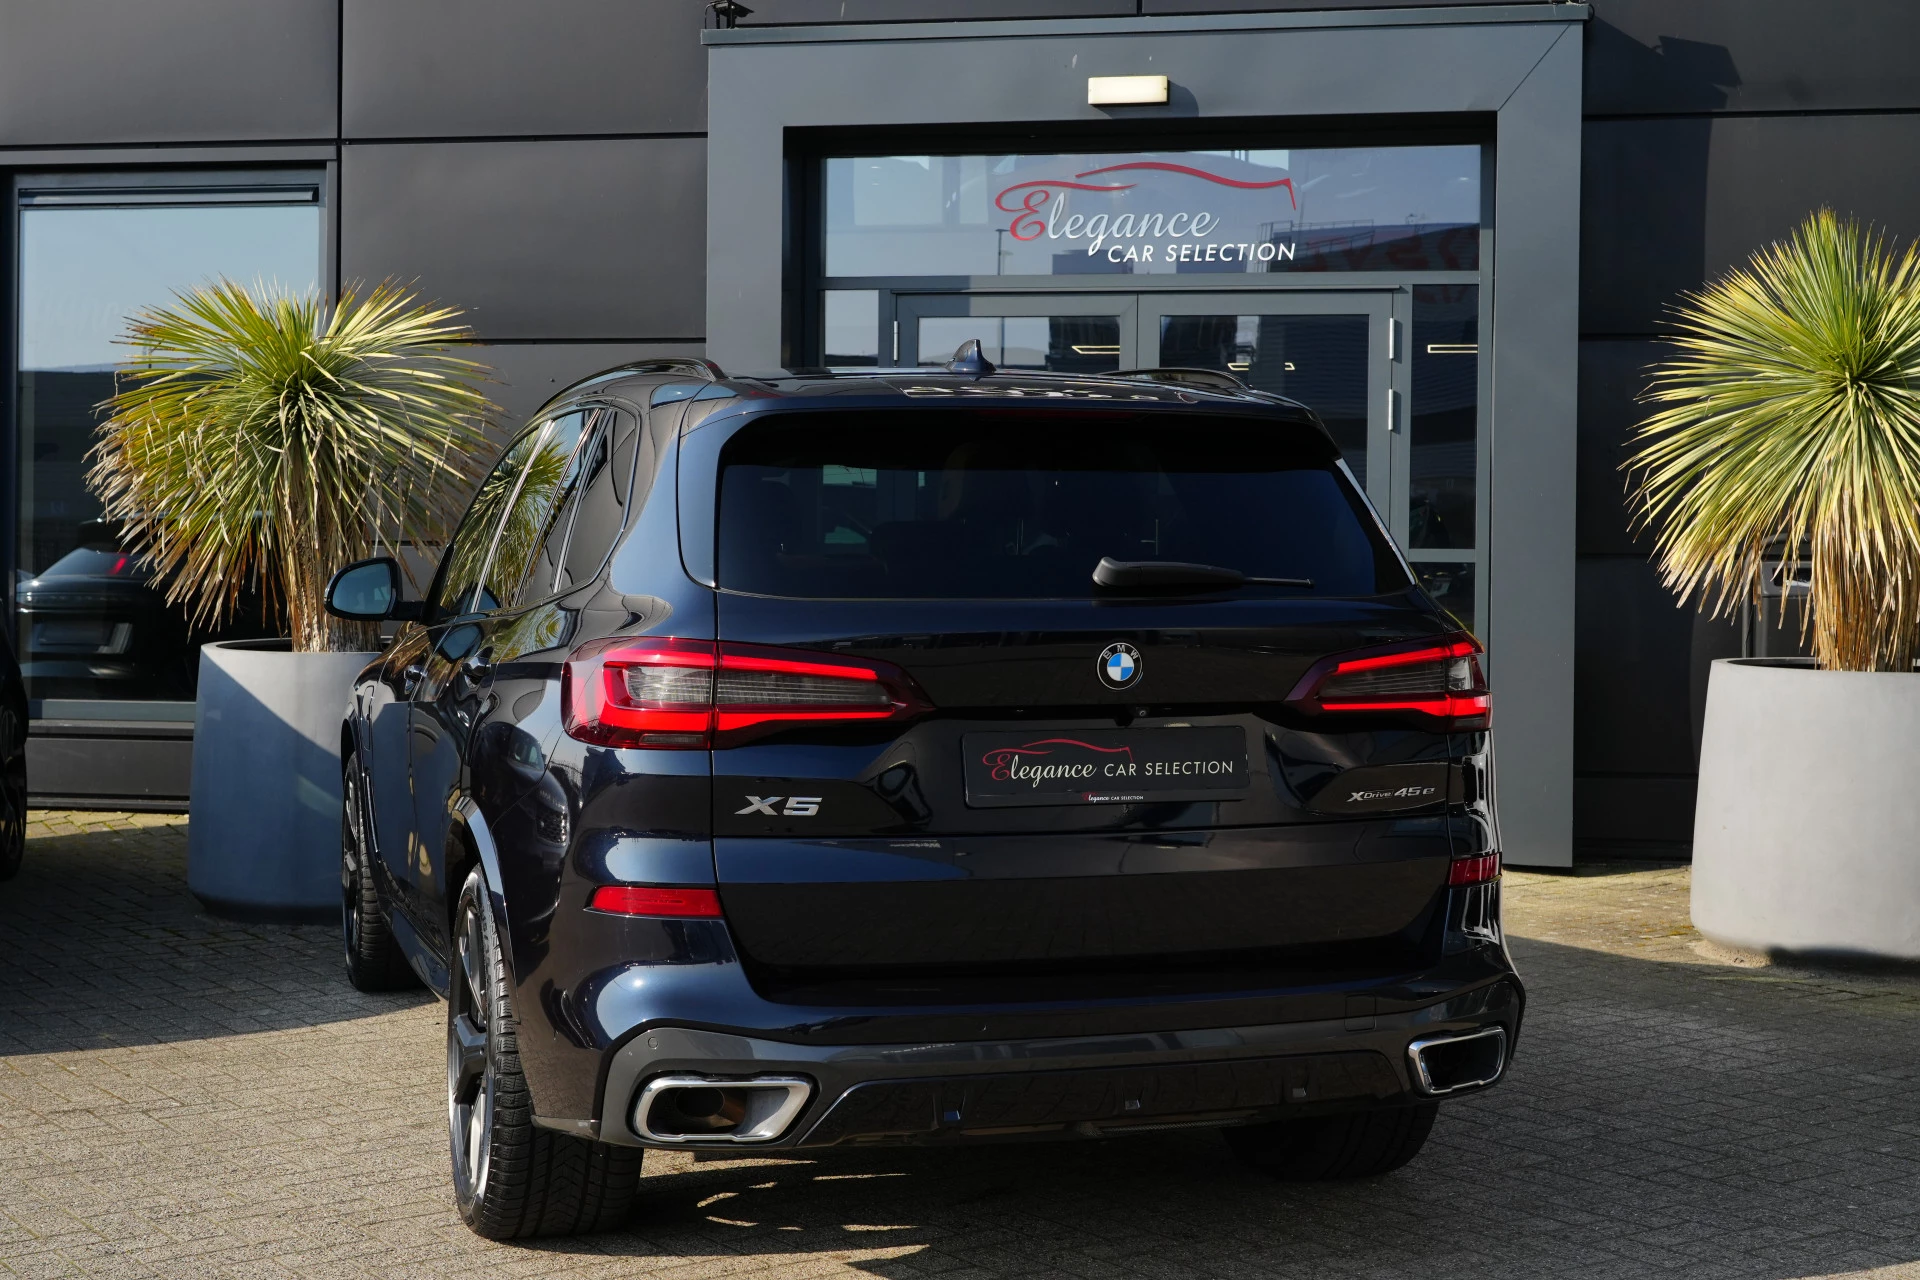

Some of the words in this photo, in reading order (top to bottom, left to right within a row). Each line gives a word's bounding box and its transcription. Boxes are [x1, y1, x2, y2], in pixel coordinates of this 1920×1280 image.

[995, 182, 1221, 257] Elegance
[1107, 244, 1154, 264] CAR
[1165, 242, 1297, 263] SELECTION
[1102, 644, 1139, 660] BMW
[982, 749, 1098, 788] Elegance
[1104, 762, 1137, 777] CAR
[1145, 760, 1234, 776] SELECTION
[734, 795, 823, 816] X5
